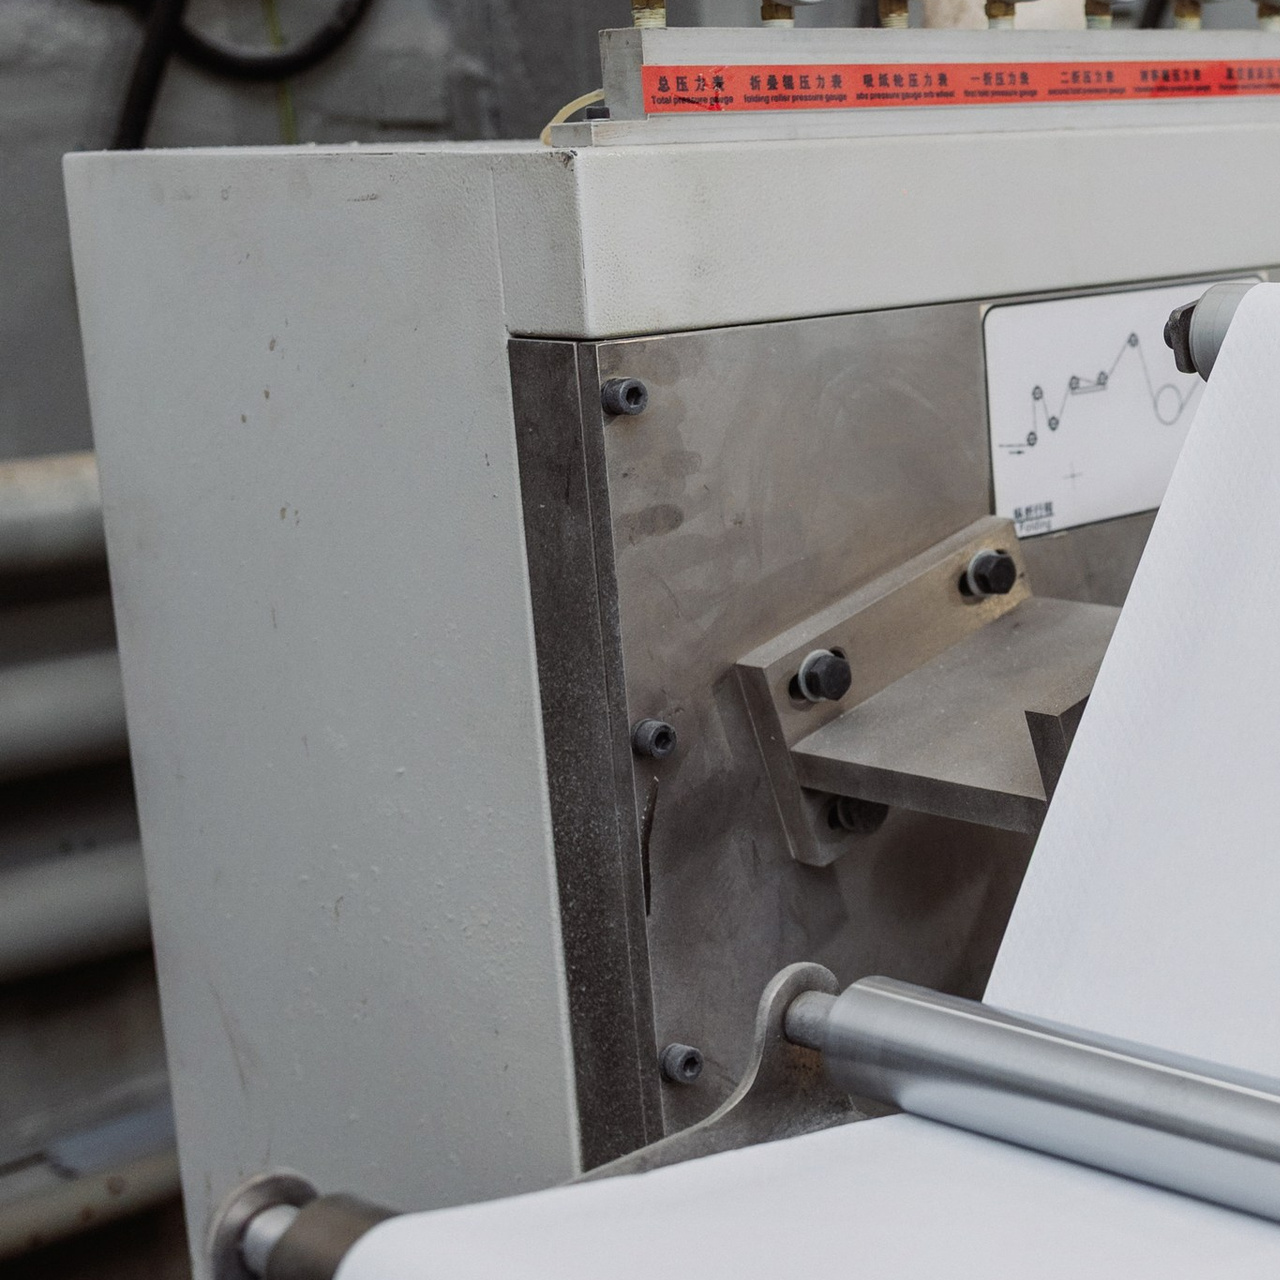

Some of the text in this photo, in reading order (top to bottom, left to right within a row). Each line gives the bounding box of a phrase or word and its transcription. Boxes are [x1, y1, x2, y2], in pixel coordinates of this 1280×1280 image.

[651, 95, 672, 104] Total
[673, 95, 708, 106] pressure
[791, 93, 824, 103] pressure
[825, 93, 848, 102] gauge
